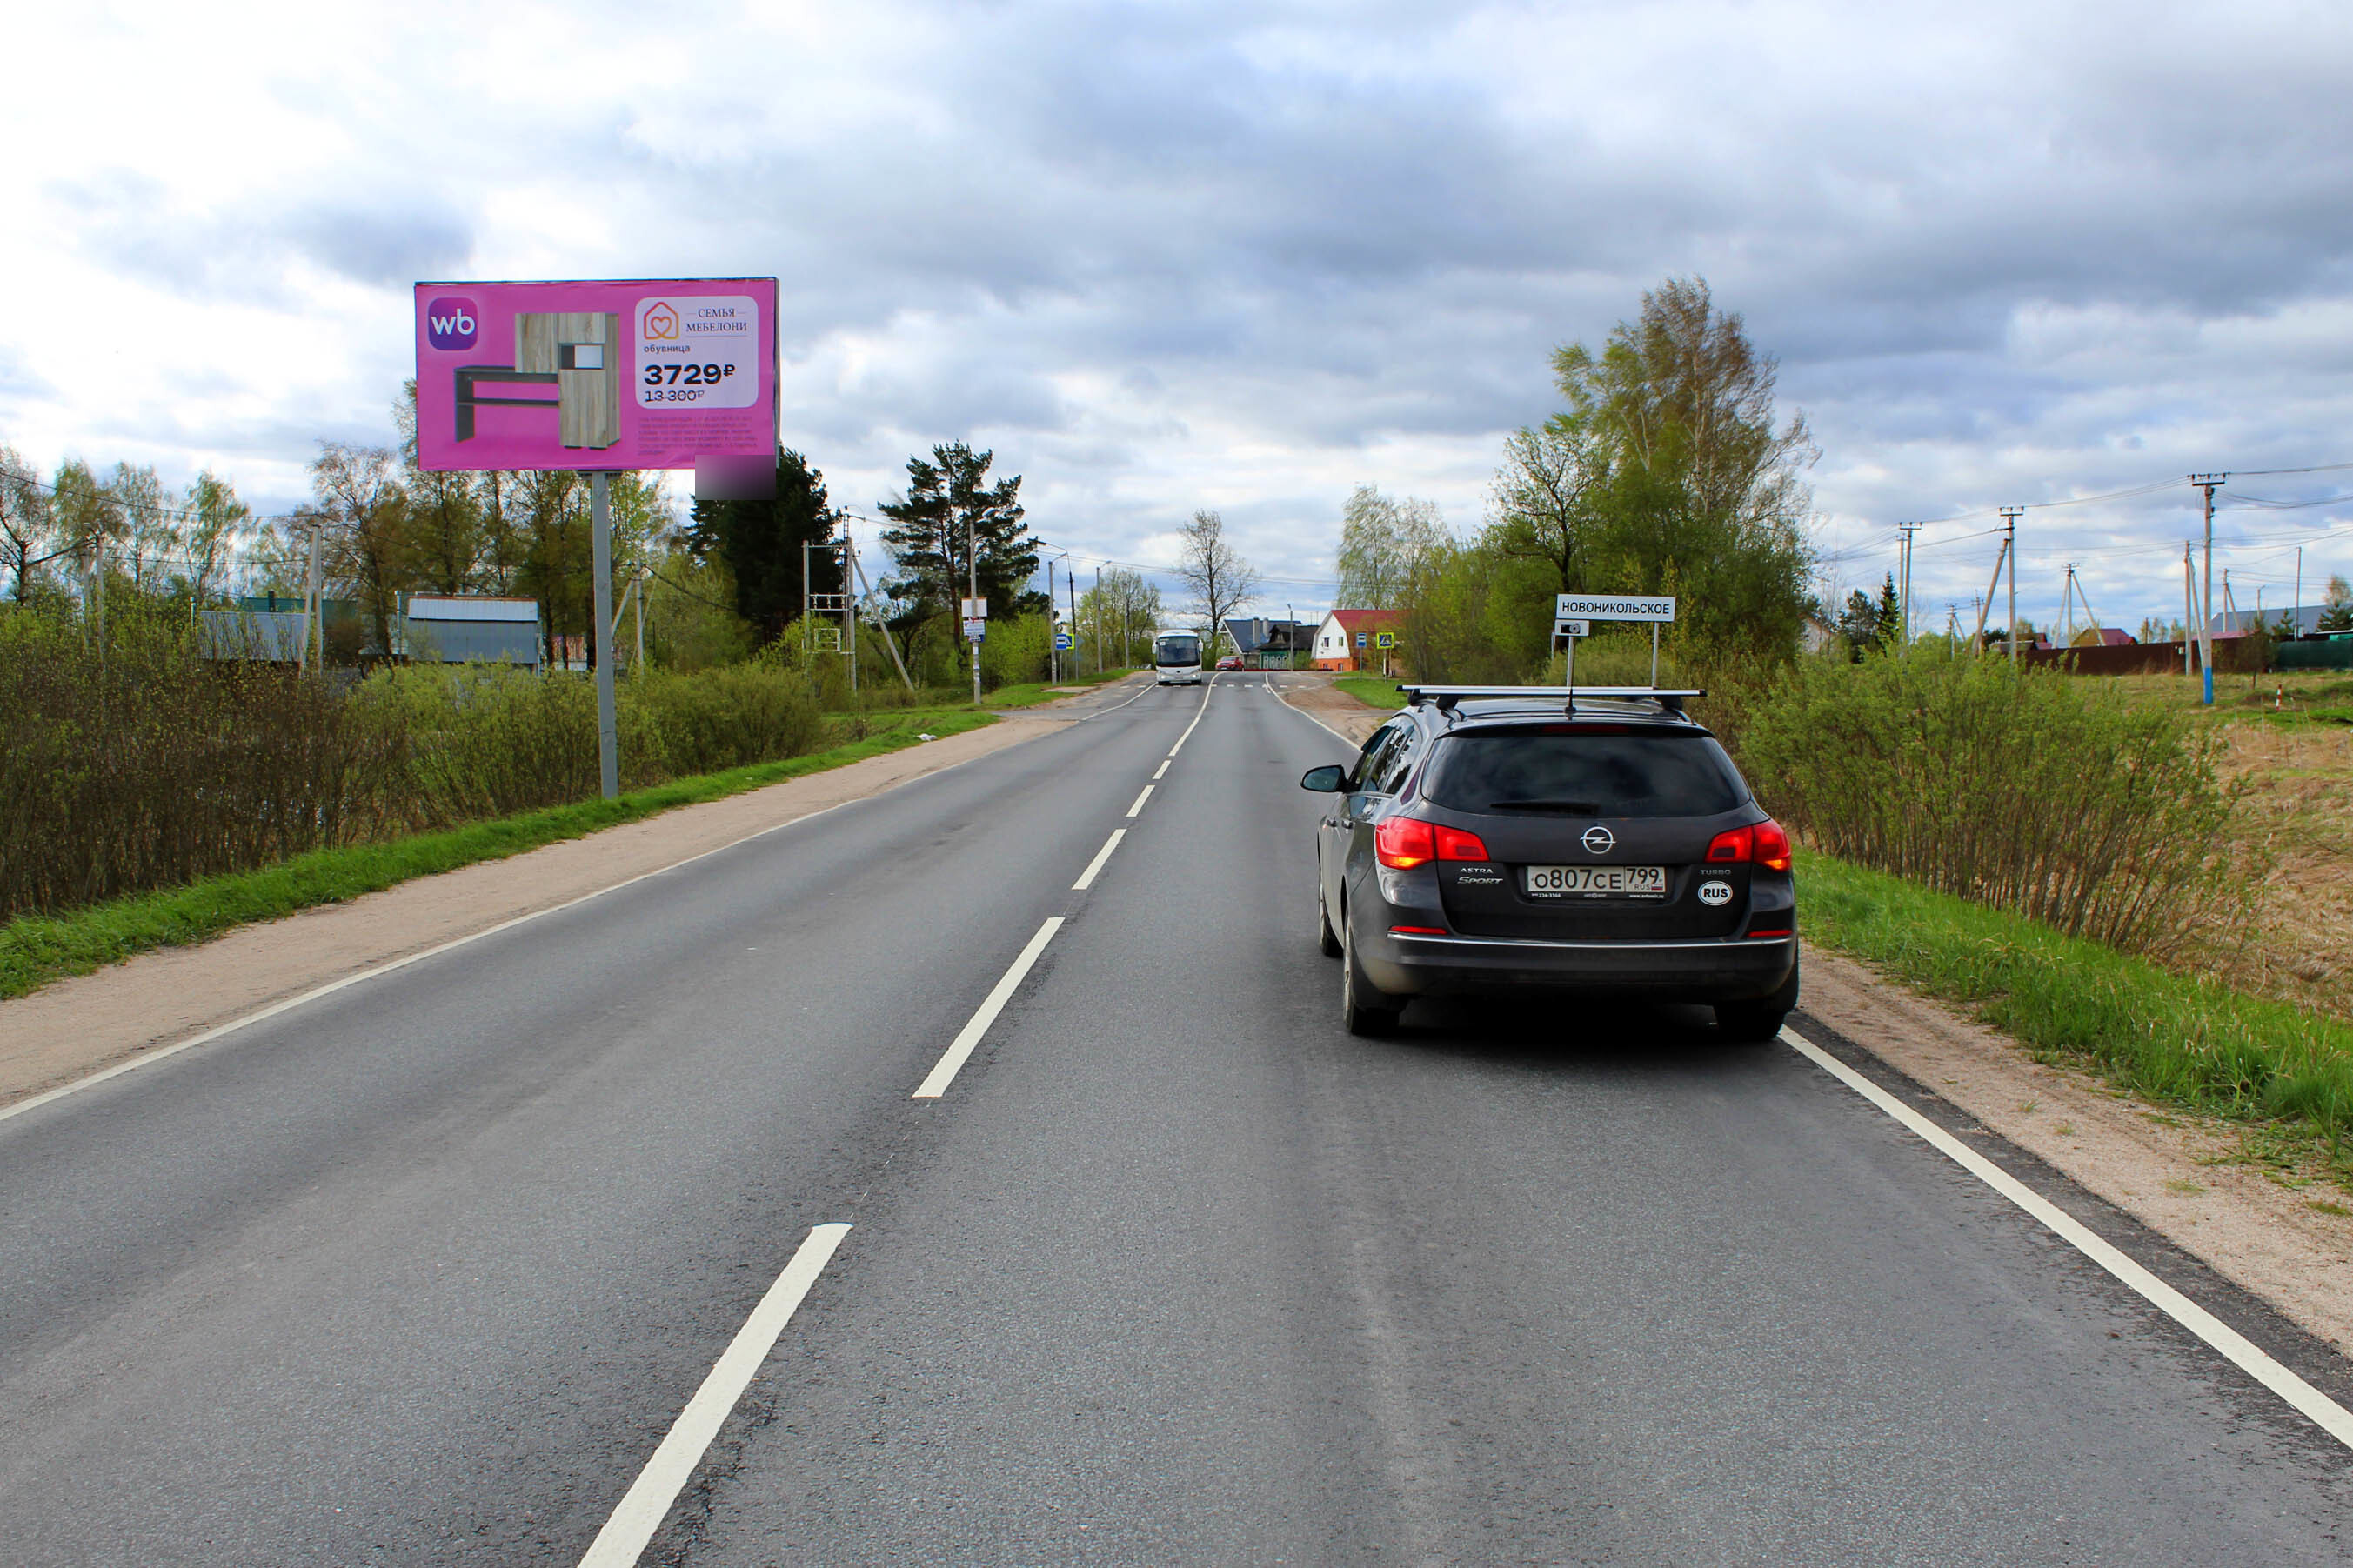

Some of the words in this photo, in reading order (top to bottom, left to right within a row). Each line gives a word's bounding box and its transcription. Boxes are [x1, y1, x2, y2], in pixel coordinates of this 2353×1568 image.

[698, 308, 735, 317] СЕМЬЯ
[431, 308, 475, 336] wb
[686, 322, 747, 332] МЕБЕЛОНИ
[644, 344, 691, 355] обувница
[1561, 601, 1671, 615] НОВОНИКОЛЬСКОЕ
[1626, 868, 1660, 884] 799
[1703, 888, 1728, 898] RUS
